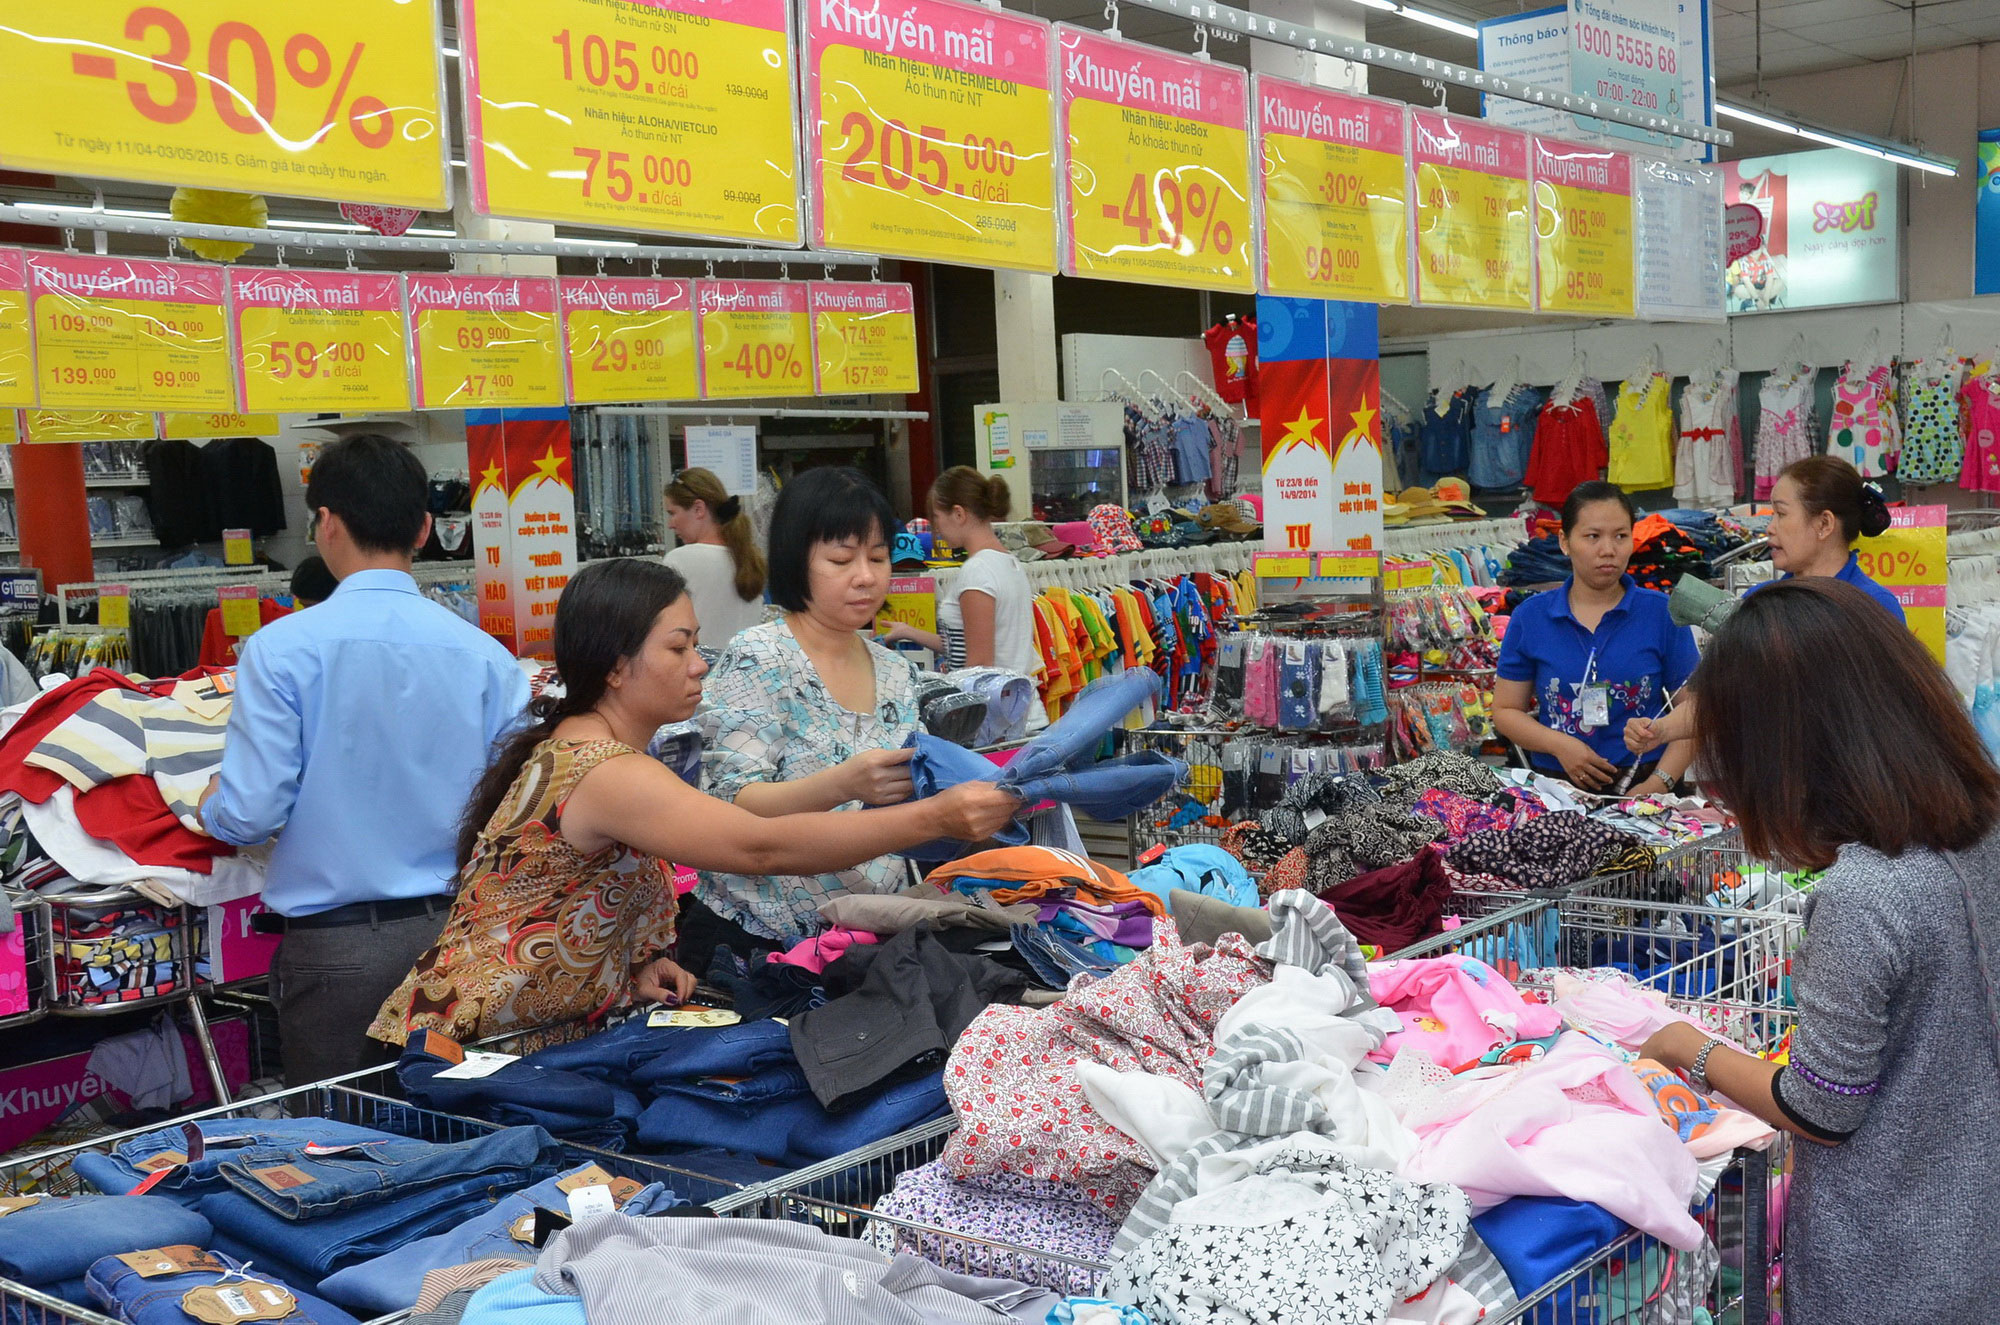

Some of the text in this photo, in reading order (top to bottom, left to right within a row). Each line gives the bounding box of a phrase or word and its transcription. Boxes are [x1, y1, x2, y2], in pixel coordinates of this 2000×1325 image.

[628, 15, 648, 28] thun
[664, 22, 677, 34] SN
[631, 2, 711, 27] ALOHA/VIETCLIO
[820, 0, 994, 65] Khuyến mãi
[1537, 27, 1559, 40] báo
[1575, 21, 1677, 75] 1900 5555 68
[72, 6, 394, 149] -30%
[864, 49, 1018, 97] Nhãn hiệu: WATERMELON
[1067, 51, 1201, 111] Khuyến mãi
[657, 80, 689, 99] đ/cái
[905, 75, 984, 107] Áo thun nữ NT
[1597, 80, 1623, 102] 07:00
[1632, 88, 1658, 110] 22:00
[584, 107, 718, 136] Nhãn hiệu: ALOHA/VIETCLIO
[1121, 109, 1208, 139] Nhãn hiệu: JoeBox
[1263, 96, 1369, 143] Khuyến mãi
[635, 128, 655, 141] thun
[670, 133, 683, 145] NT
[1128, 128, 1140, 146] Áo
[1142, 135, 1170, 151] khoác
[1170, 141, 1190, 154] thun
[55, 131, 74, 146] Từ
[79, 138, 113, 154] ngày
[338, 166, 356, 179] thu
[1475, 141, 1500, 167] mãi
[1587, 163, 1609, 186] mãi
[652, 190, 683, 207] đ/cái
[971, 179, 1010, 204] đ/cái
[1318, 171, 1368, 207] -30%
[1102, 173, 1233, 255] -49%
[33, 266, 177, 296] Khuyến mãi
[238, 281, 360, 307] Khuyến mãi
[415, 283, 490, 308] Khuyến
[566, 286, 660, 308] Khuyến mãi
[701, 287, 783, 311] Khuyến mãi
[814, 290, 888, 311] Khuyến mãi
[723, 343, 803, 379] -40%
[205, 413, 246, 429] -30%
[1280, 489, 1317, 500] 14/9/2014
[1285, 477, 1303, 487] 23/8
[1891, 510, 1915, 527] mãi
[896, 536, 916, 550] OY
[1286, 522, 1312, 551] TỰ
[486, 546, 500, 568] TỰ
[485, 580, 506, 601] HÀO
[525, 575, 569, 592] VIỆT NAM
